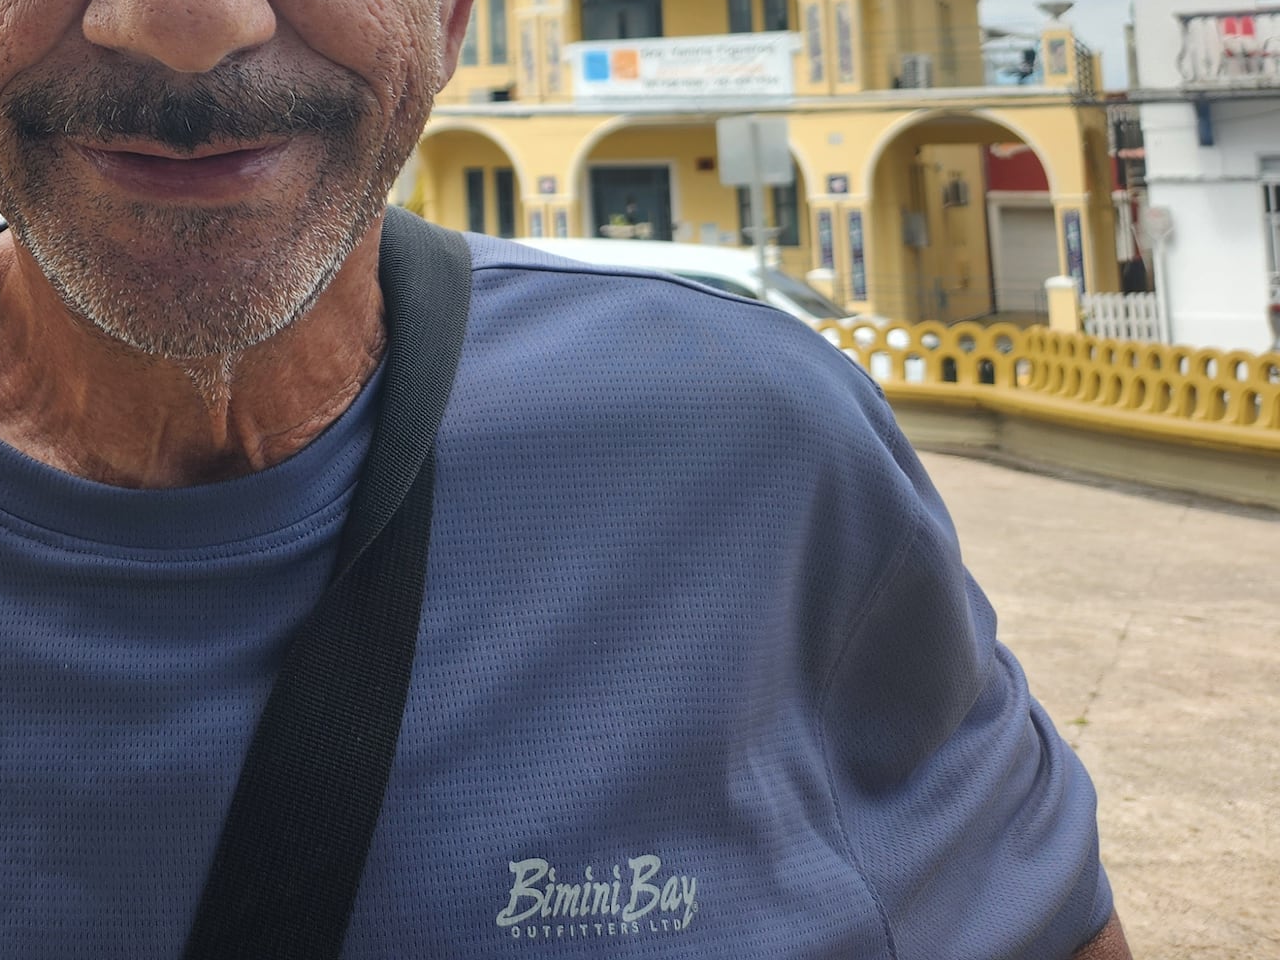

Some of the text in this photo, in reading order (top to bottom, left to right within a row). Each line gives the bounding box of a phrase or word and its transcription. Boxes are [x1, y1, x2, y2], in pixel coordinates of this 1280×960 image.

[496, 854, 696, 929] Bimini Bay
[511, 918, 681, 938] OUTFITTERS LTD
